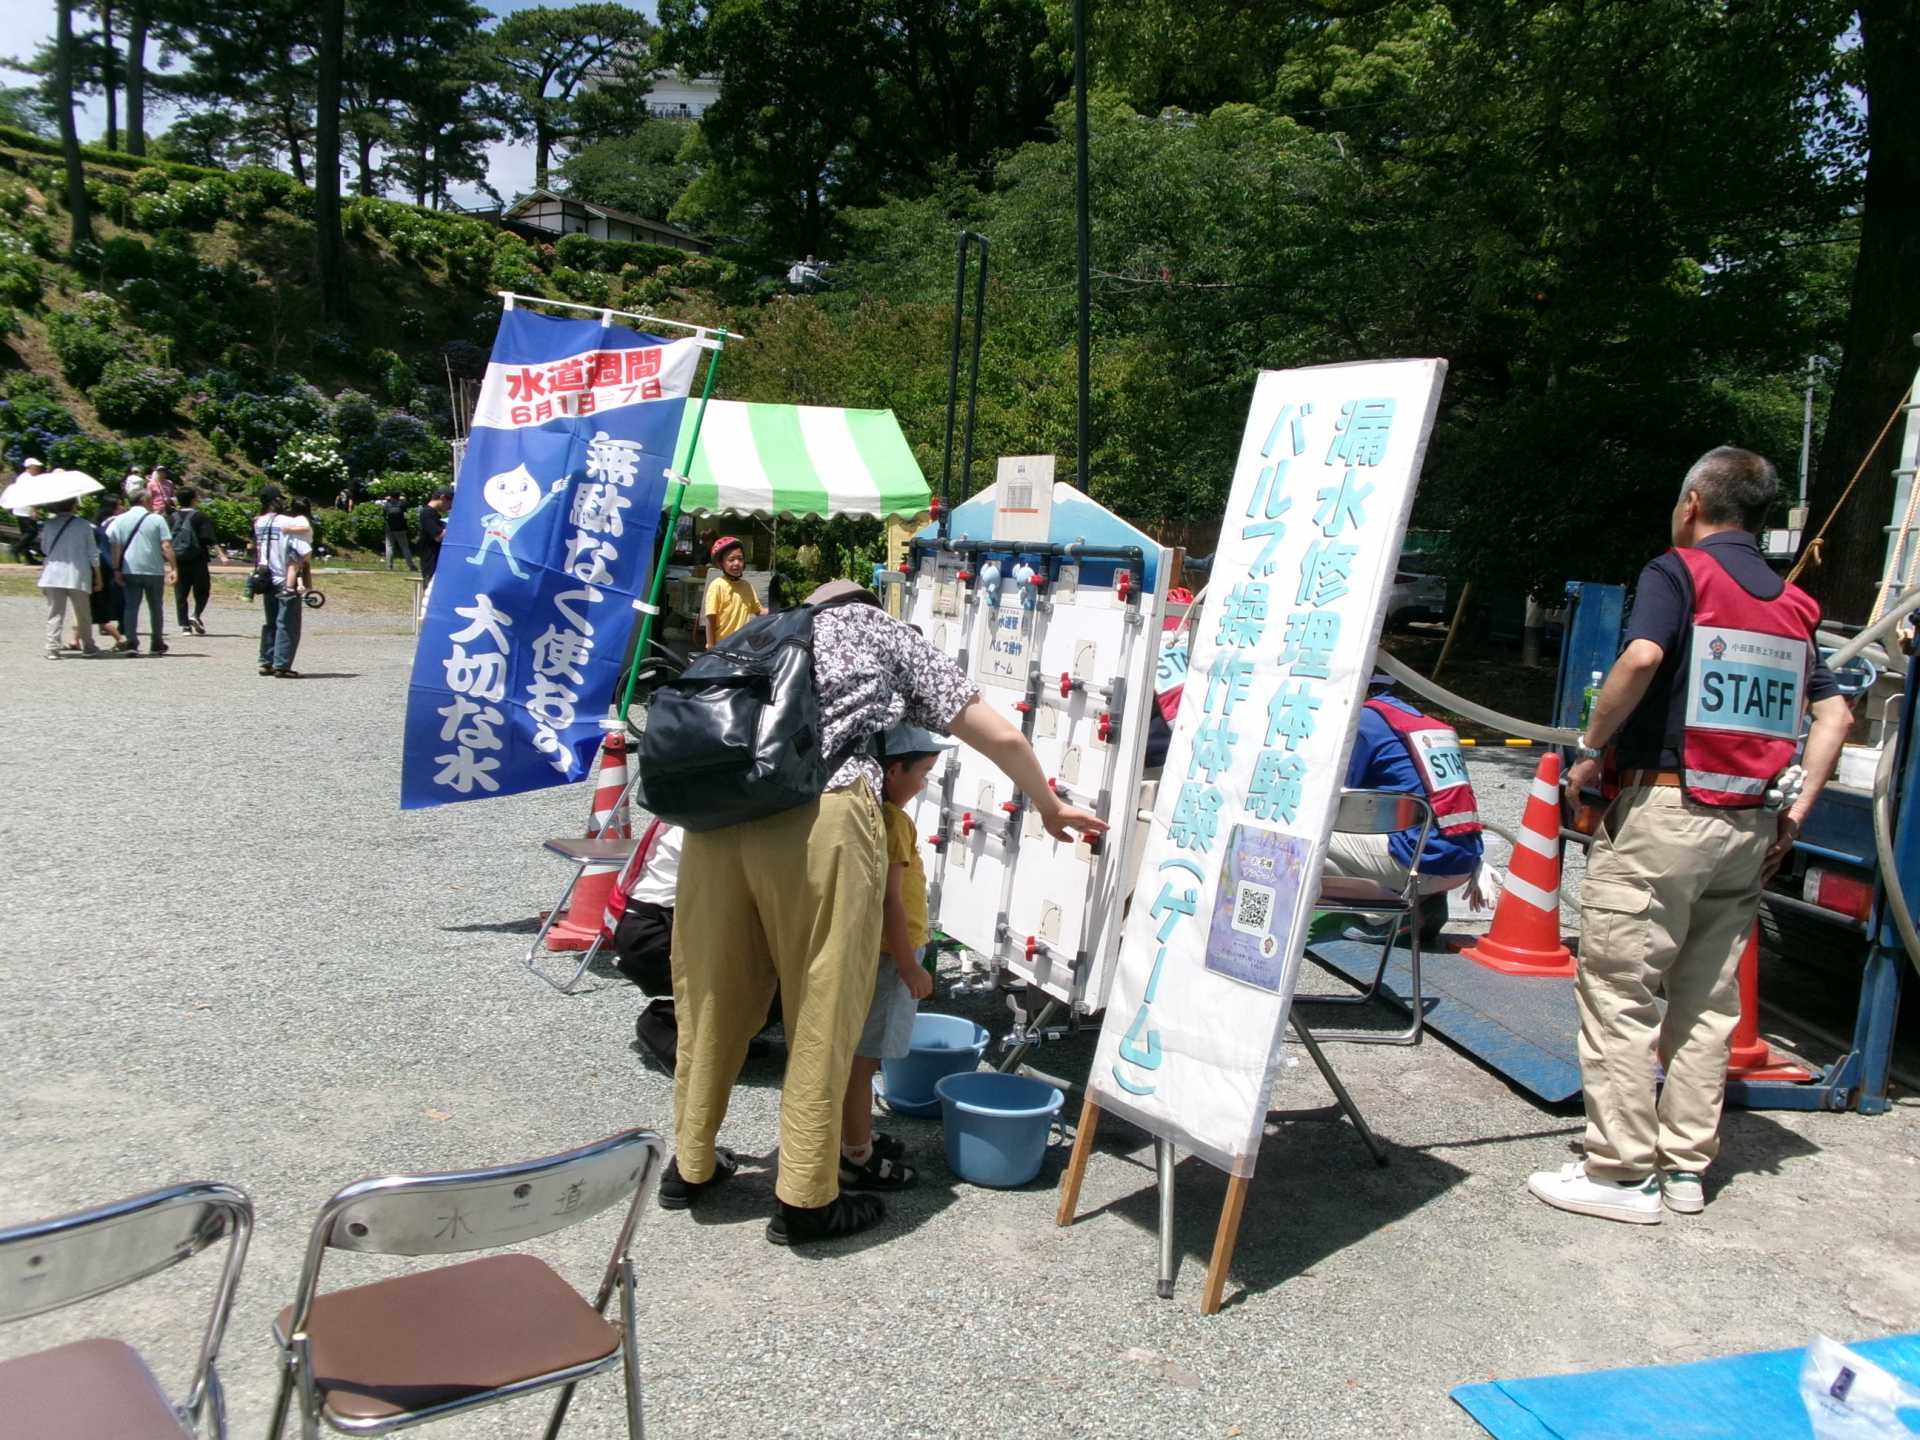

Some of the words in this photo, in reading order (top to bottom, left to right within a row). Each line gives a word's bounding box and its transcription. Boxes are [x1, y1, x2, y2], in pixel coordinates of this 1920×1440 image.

[505, 348, 662, 402] 水道週間
[510, 378, 662, 425] 6月1日7日
[525, 430, 643, 773] 無駄なく使おう
[1244, 396, 1397, 826] 漏水修理体験
[433, 593, 513, 793] 大切な水
[1701, 671, 1794, 721] STAFF
